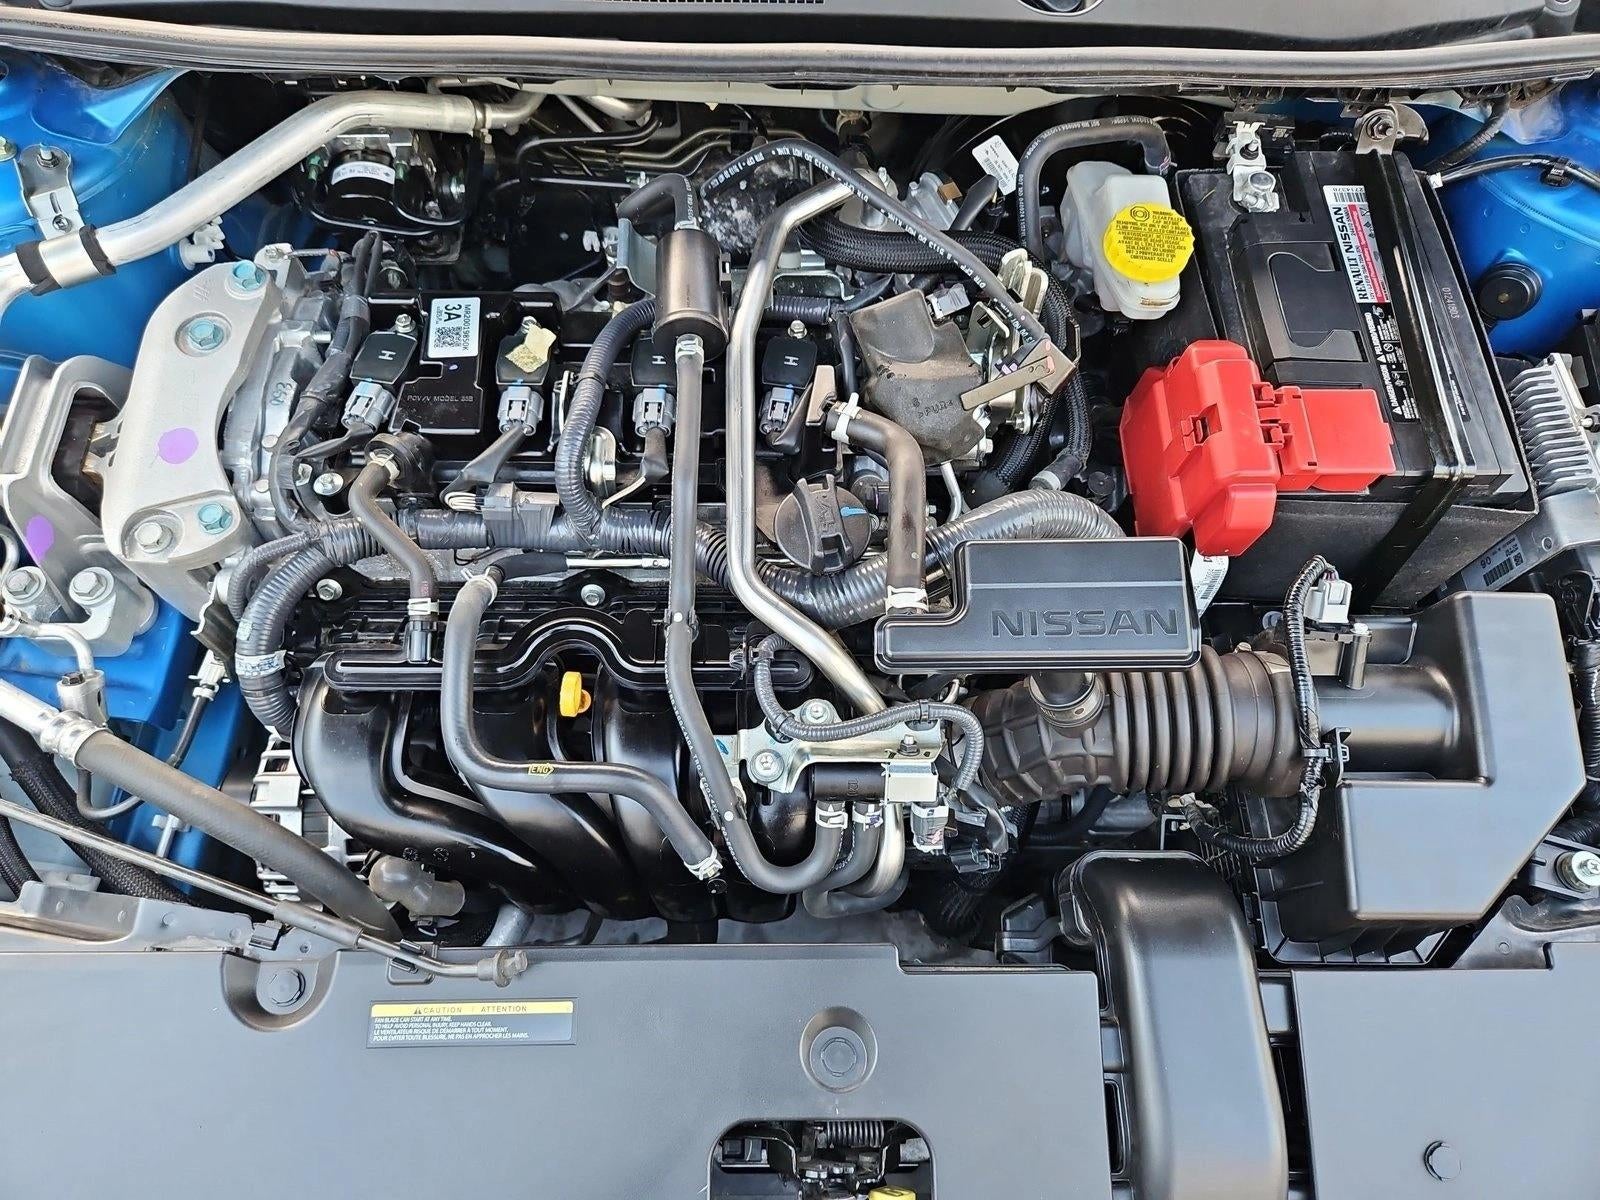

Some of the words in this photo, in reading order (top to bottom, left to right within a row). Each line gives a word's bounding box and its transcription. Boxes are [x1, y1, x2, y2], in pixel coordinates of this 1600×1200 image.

[1334, 206, 1354, 252] NISSAN
[1350, 255, 1368, 300] RENAULT
[443, 303, 462, 322] 3A
[991, 609, 1179, 637] NISSAN
